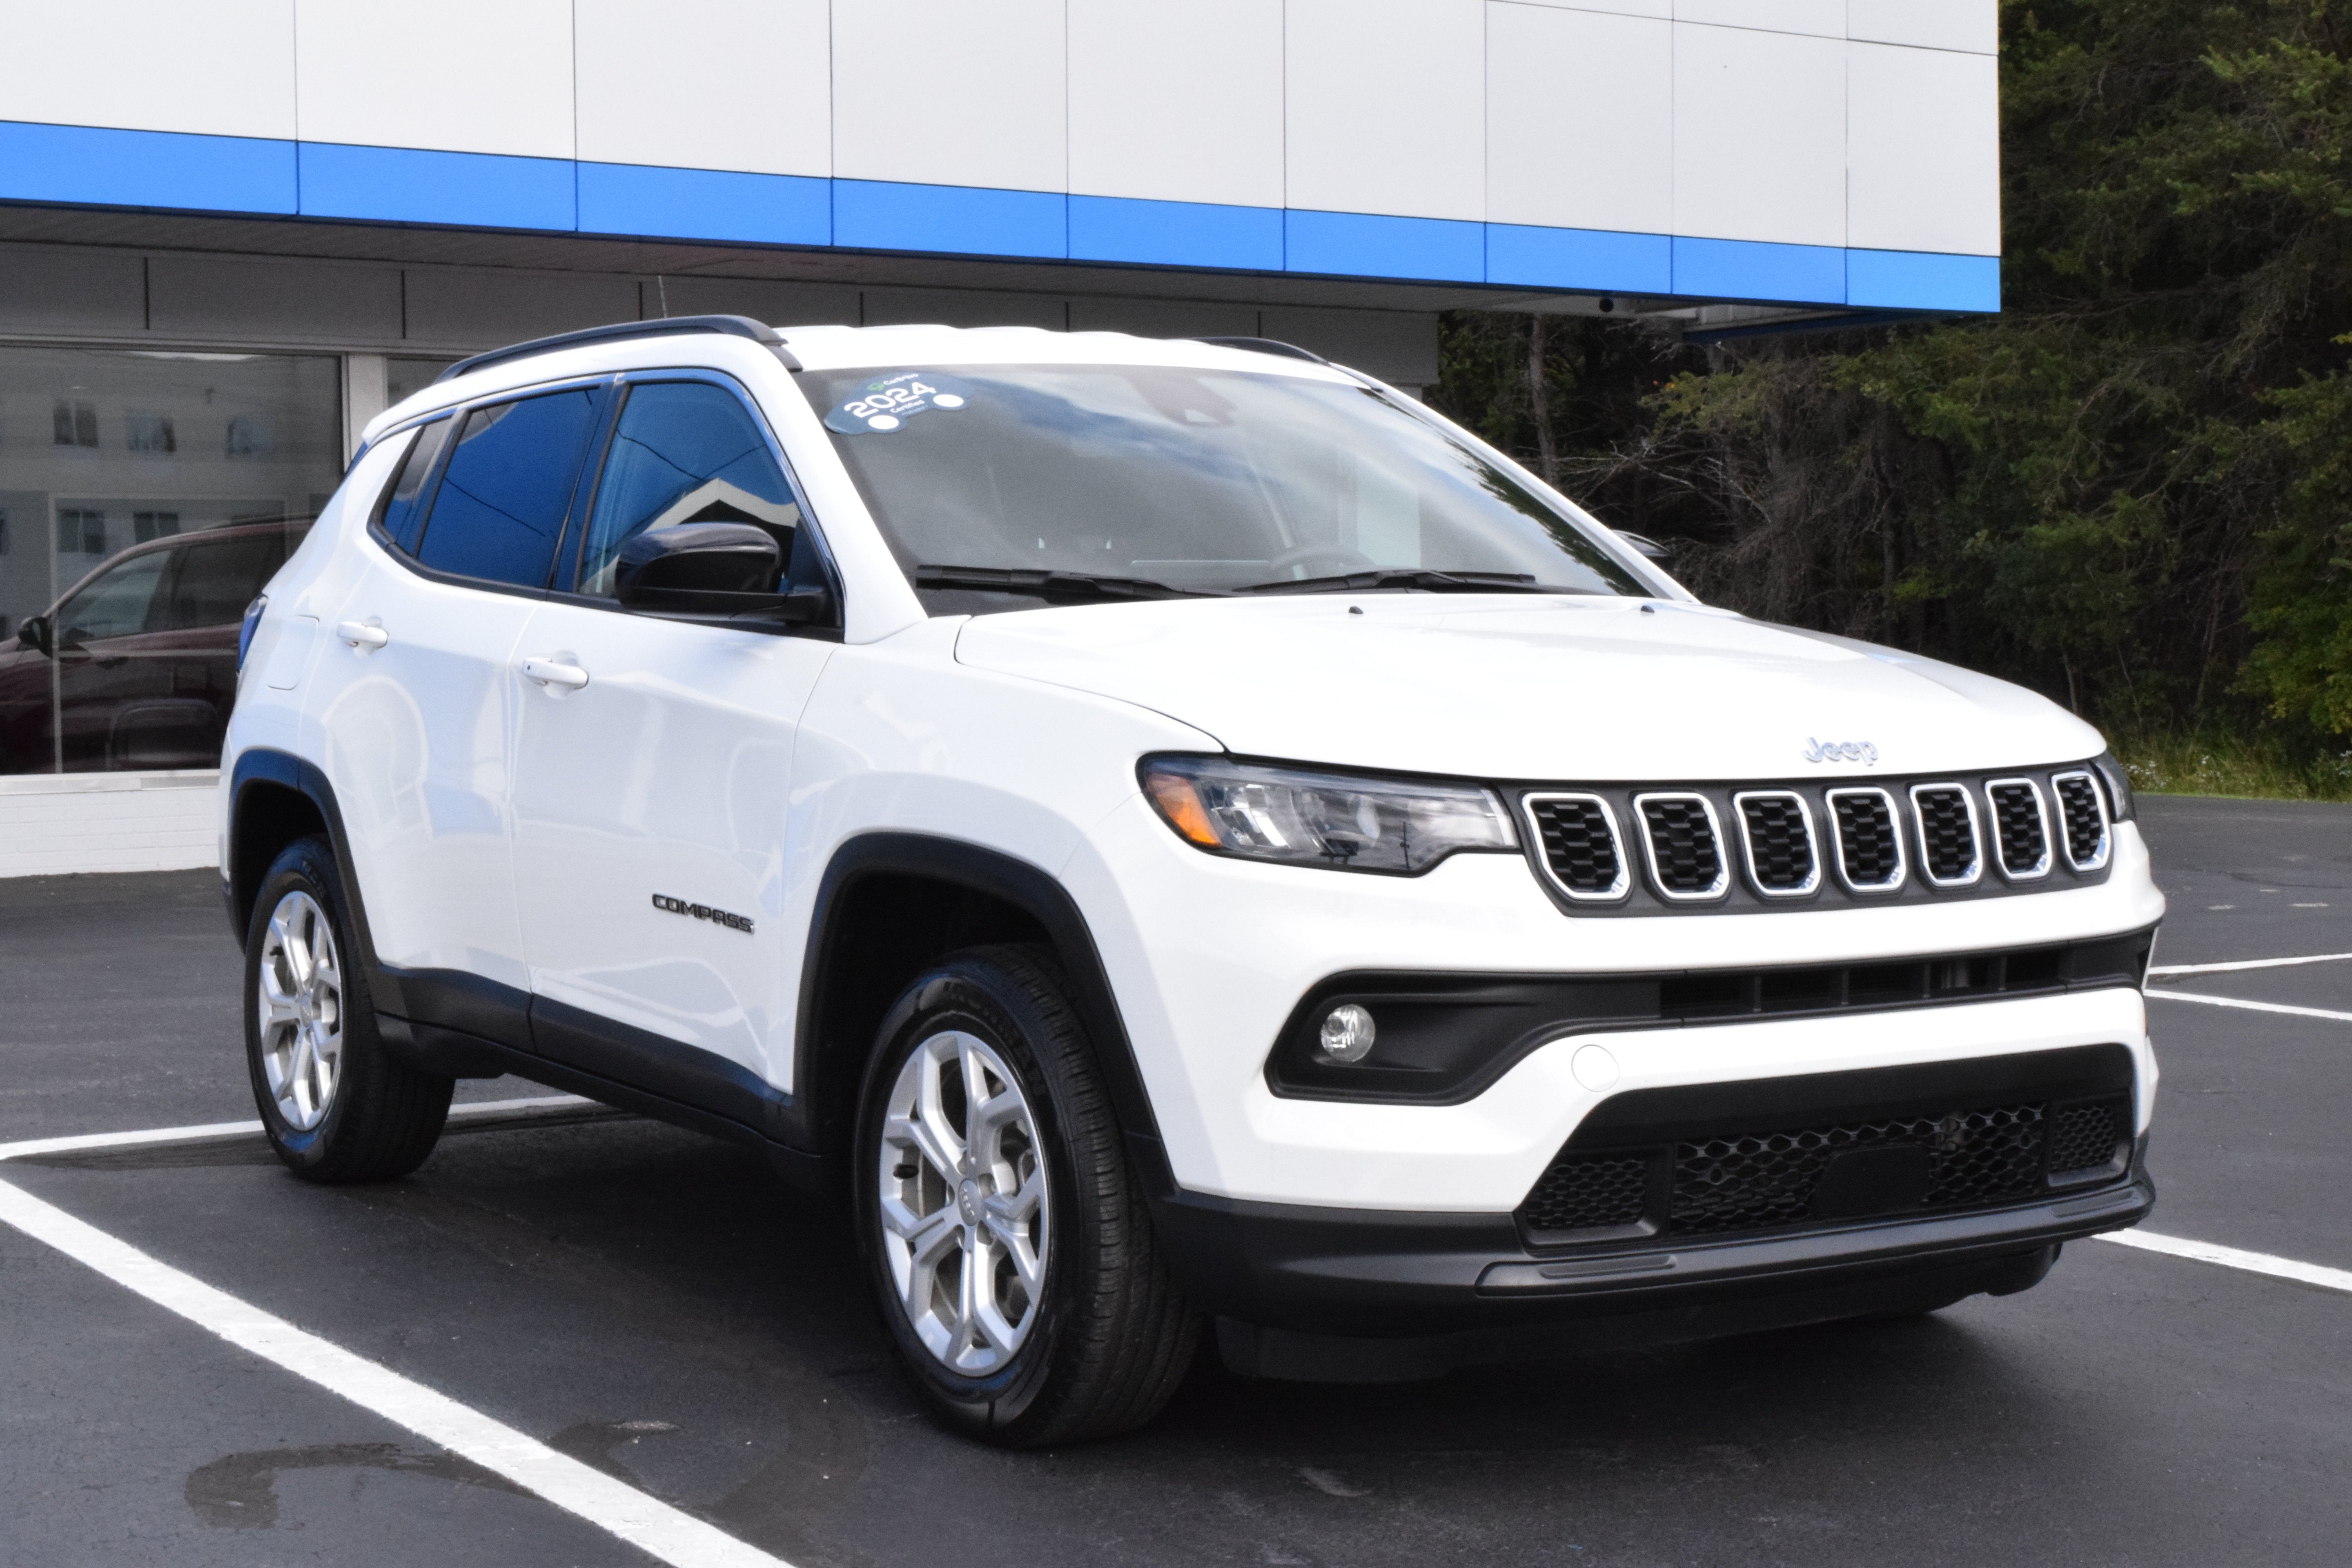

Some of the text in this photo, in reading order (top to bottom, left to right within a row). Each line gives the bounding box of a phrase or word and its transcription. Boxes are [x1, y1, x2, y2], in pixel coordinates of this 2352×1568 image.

[844, 382, 936, 418] 2024
[1800, 737, 1878, 766] Jeep
[653, 893, 754, 934] COMPASS
